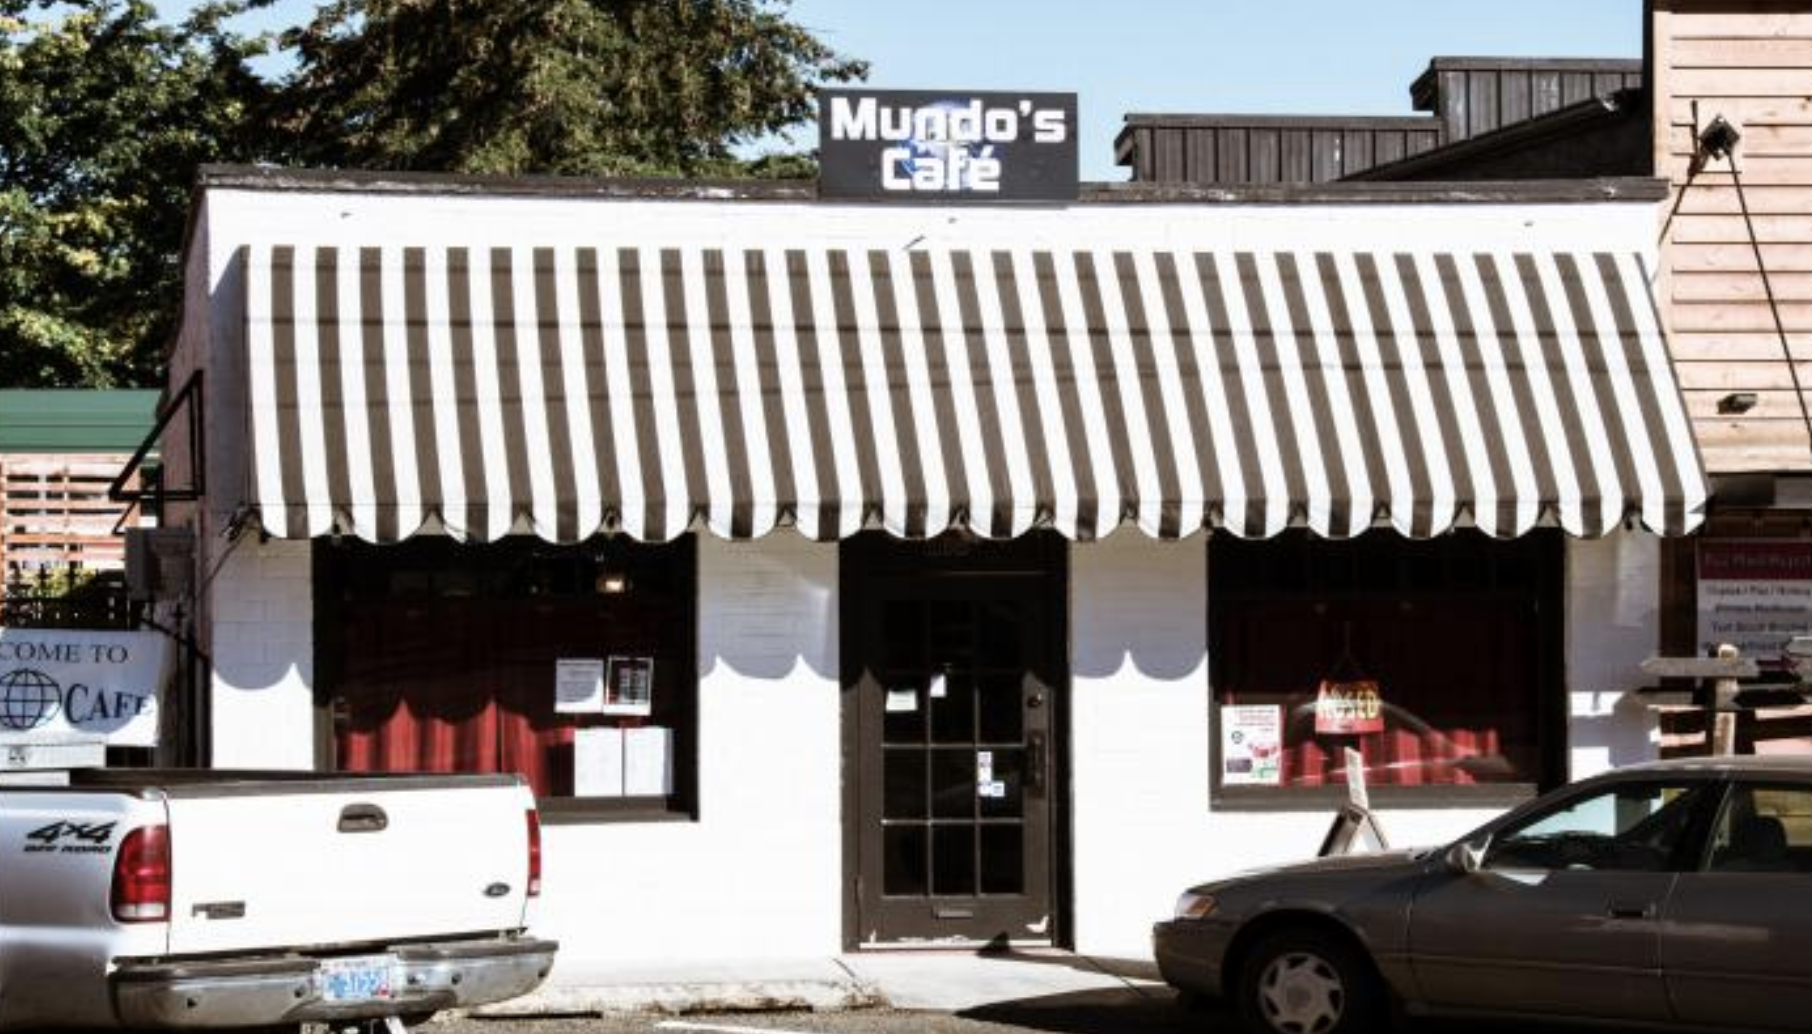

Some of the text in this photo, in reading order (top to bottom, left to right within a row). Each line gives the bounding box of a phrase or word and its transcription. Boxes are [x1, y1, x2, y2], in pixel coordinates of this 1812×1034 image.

[831, 97, 1066, 143] Mundo's
[881, 145, 1002, 190] Café
[92, 645, 128, 663] TO
